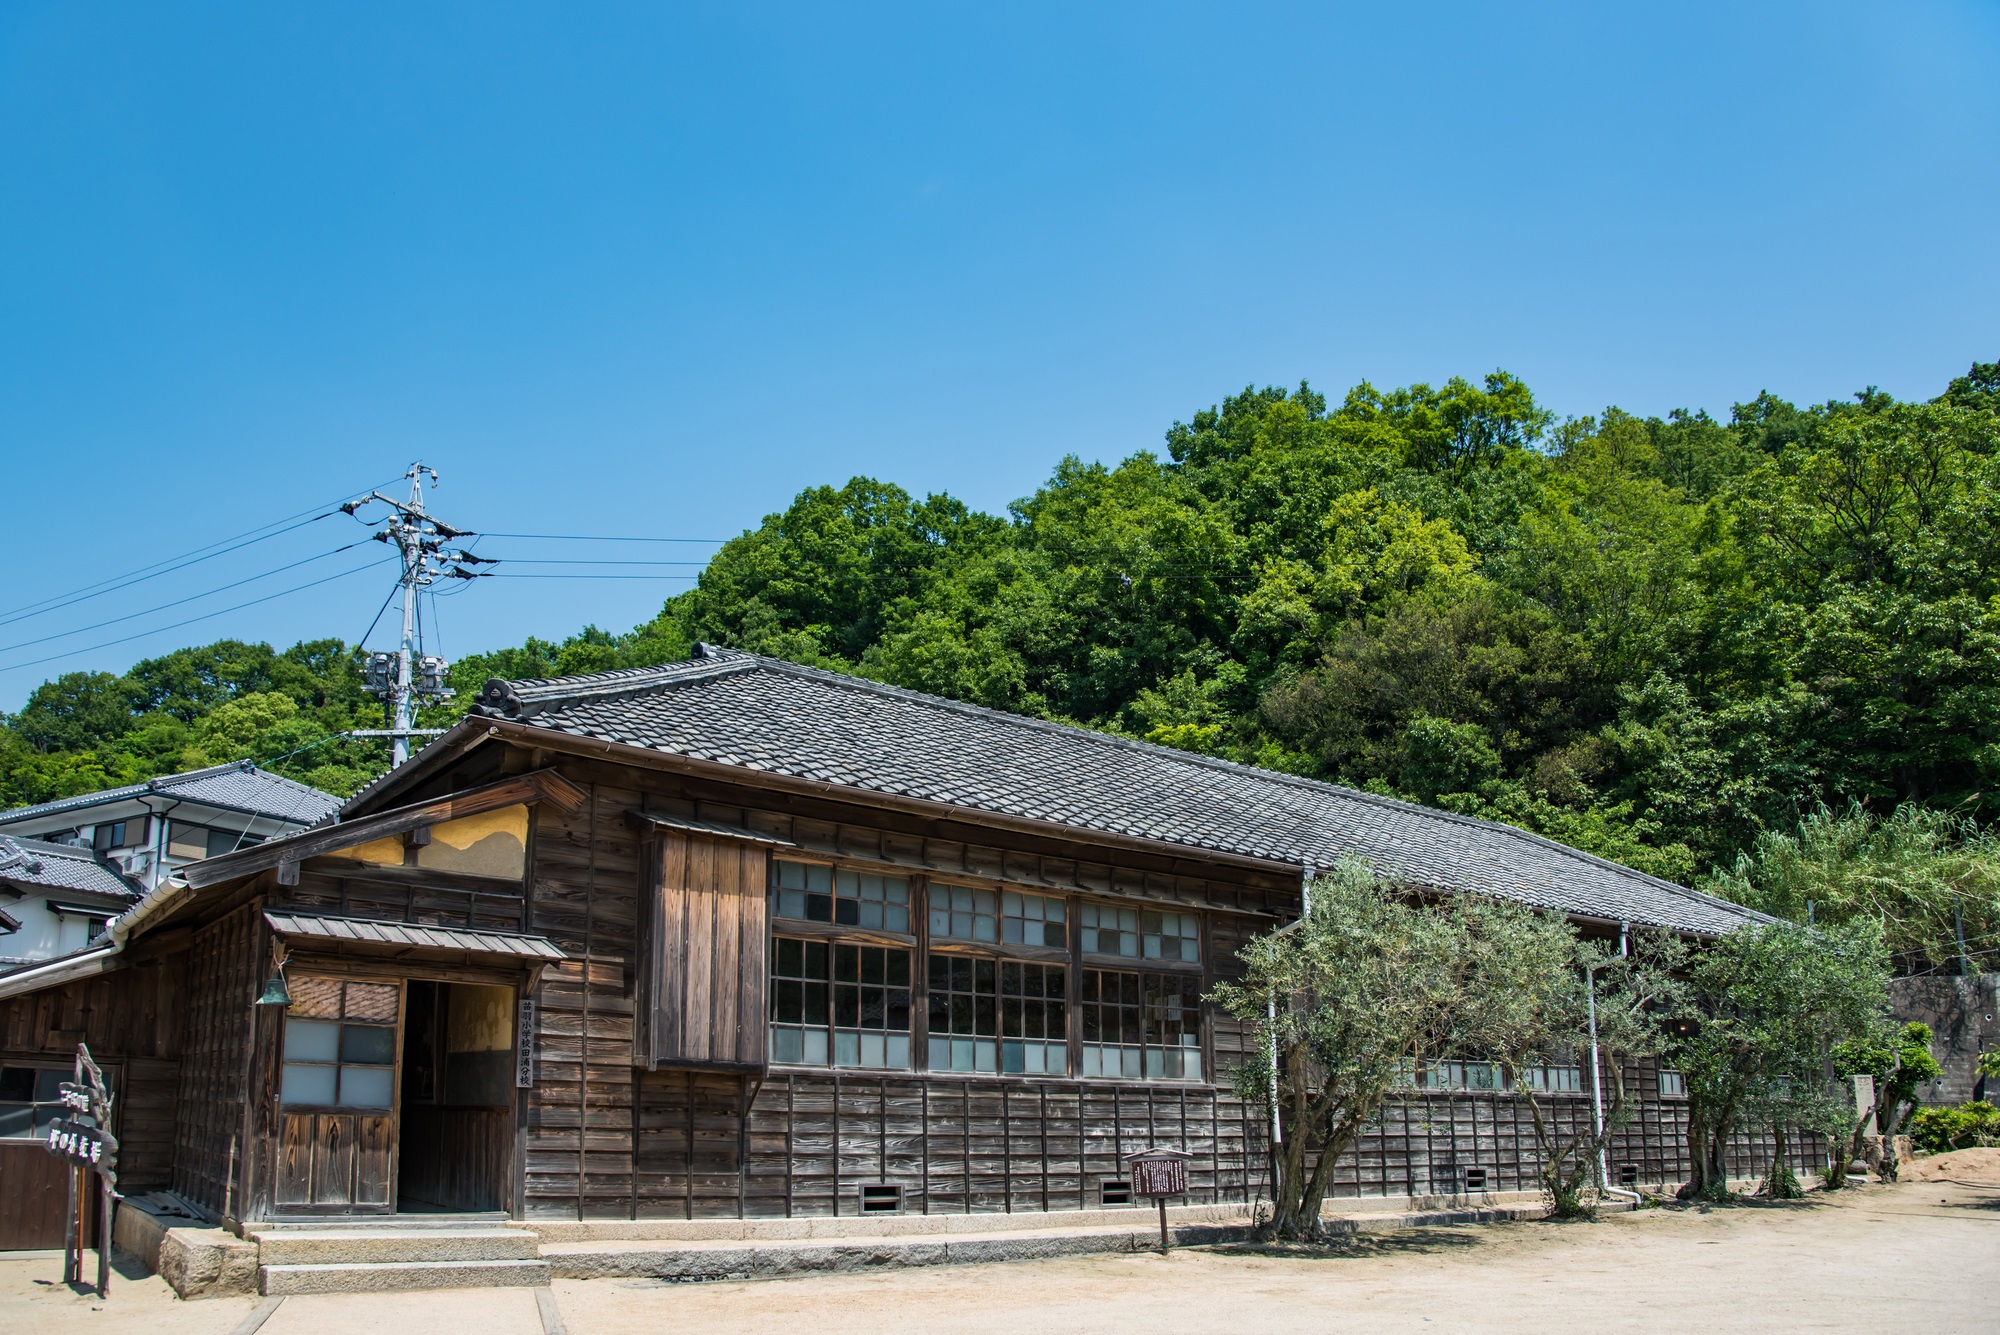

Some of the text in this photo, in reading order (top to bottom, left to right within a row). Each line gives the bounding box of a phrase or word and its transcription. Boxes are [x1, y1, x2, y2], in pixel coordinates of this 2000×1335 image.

[520, 1002, 532, 1086] 苗羽小学校田浦分校
